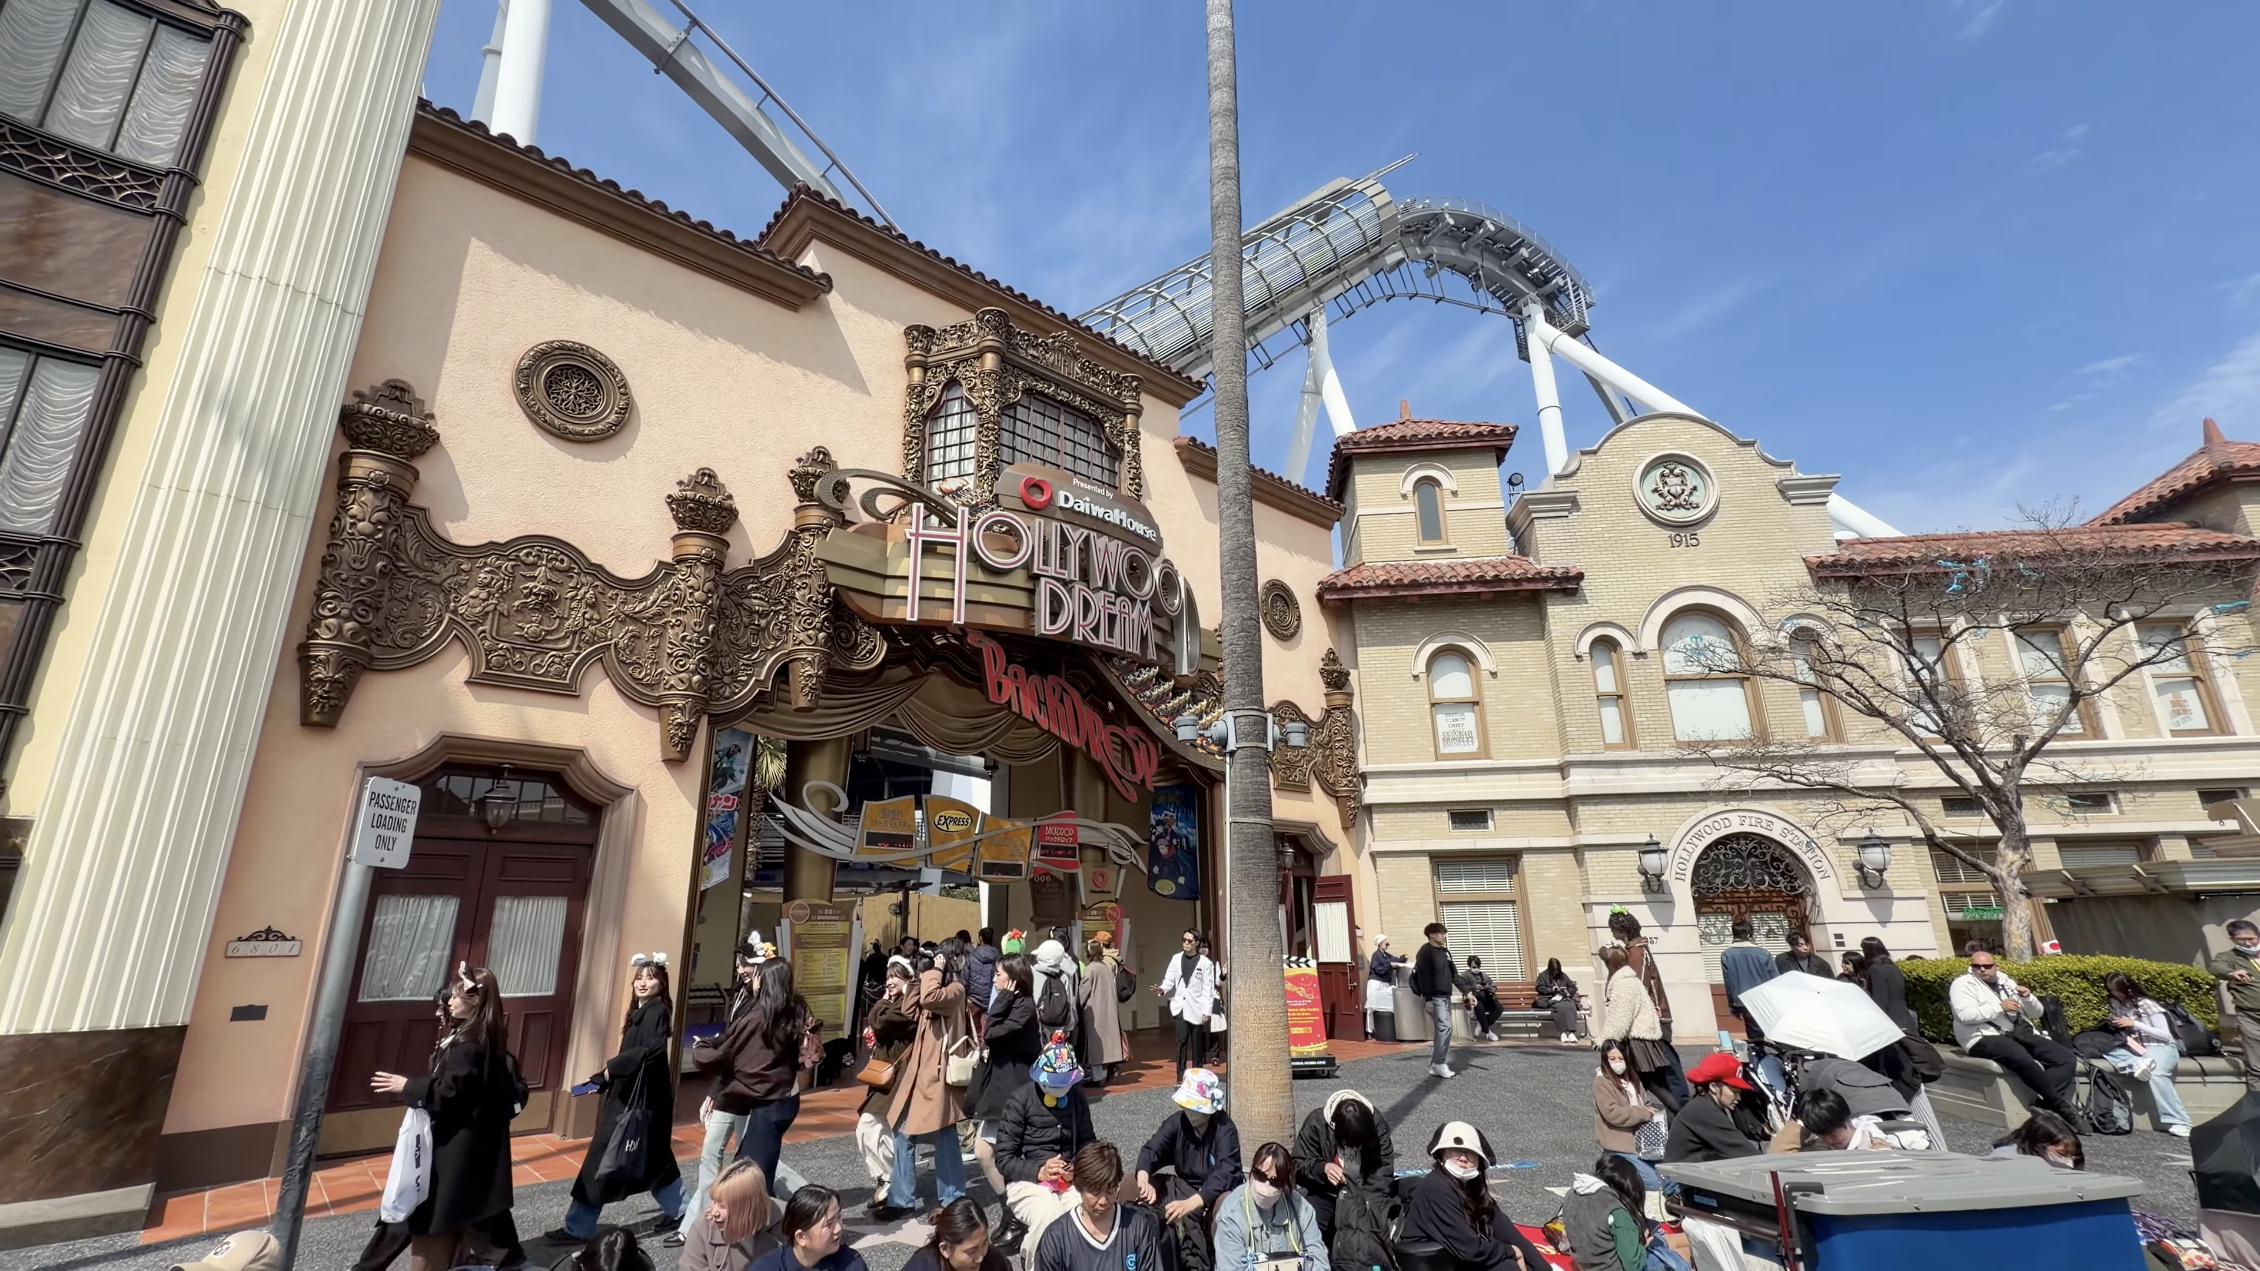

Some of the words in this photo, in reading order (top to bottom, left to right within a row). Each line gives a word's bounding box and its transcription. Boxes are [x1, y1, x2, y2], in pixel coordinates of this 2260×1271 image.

[1073, 478, 1105, 495] Presented
[1105, 488, 1114, 500] by
[1668, 533, 1701, 548] 1915
[905, 502, 1201, 677] HOLLYWOOD
[1035, 576, 1158, 661] DREAM
[967, 634, 1159, 803] BACKDROP
[369, 791, 416, 815] PASSENGER
[371, 812, 408, 833] LOADING
[937, 815, 970, 830] EXPRESS
[1045, 826, 1074, 837] BACKDROP
[375, 834, 397, 852] ONLY
[1675, 817, 1732, 882] HOLLYWOOD
[1738, 815, 1774, 831] FIRE
[1779, 827, 1831, 880] STATION
[231, 943, 296, 954] 6801
